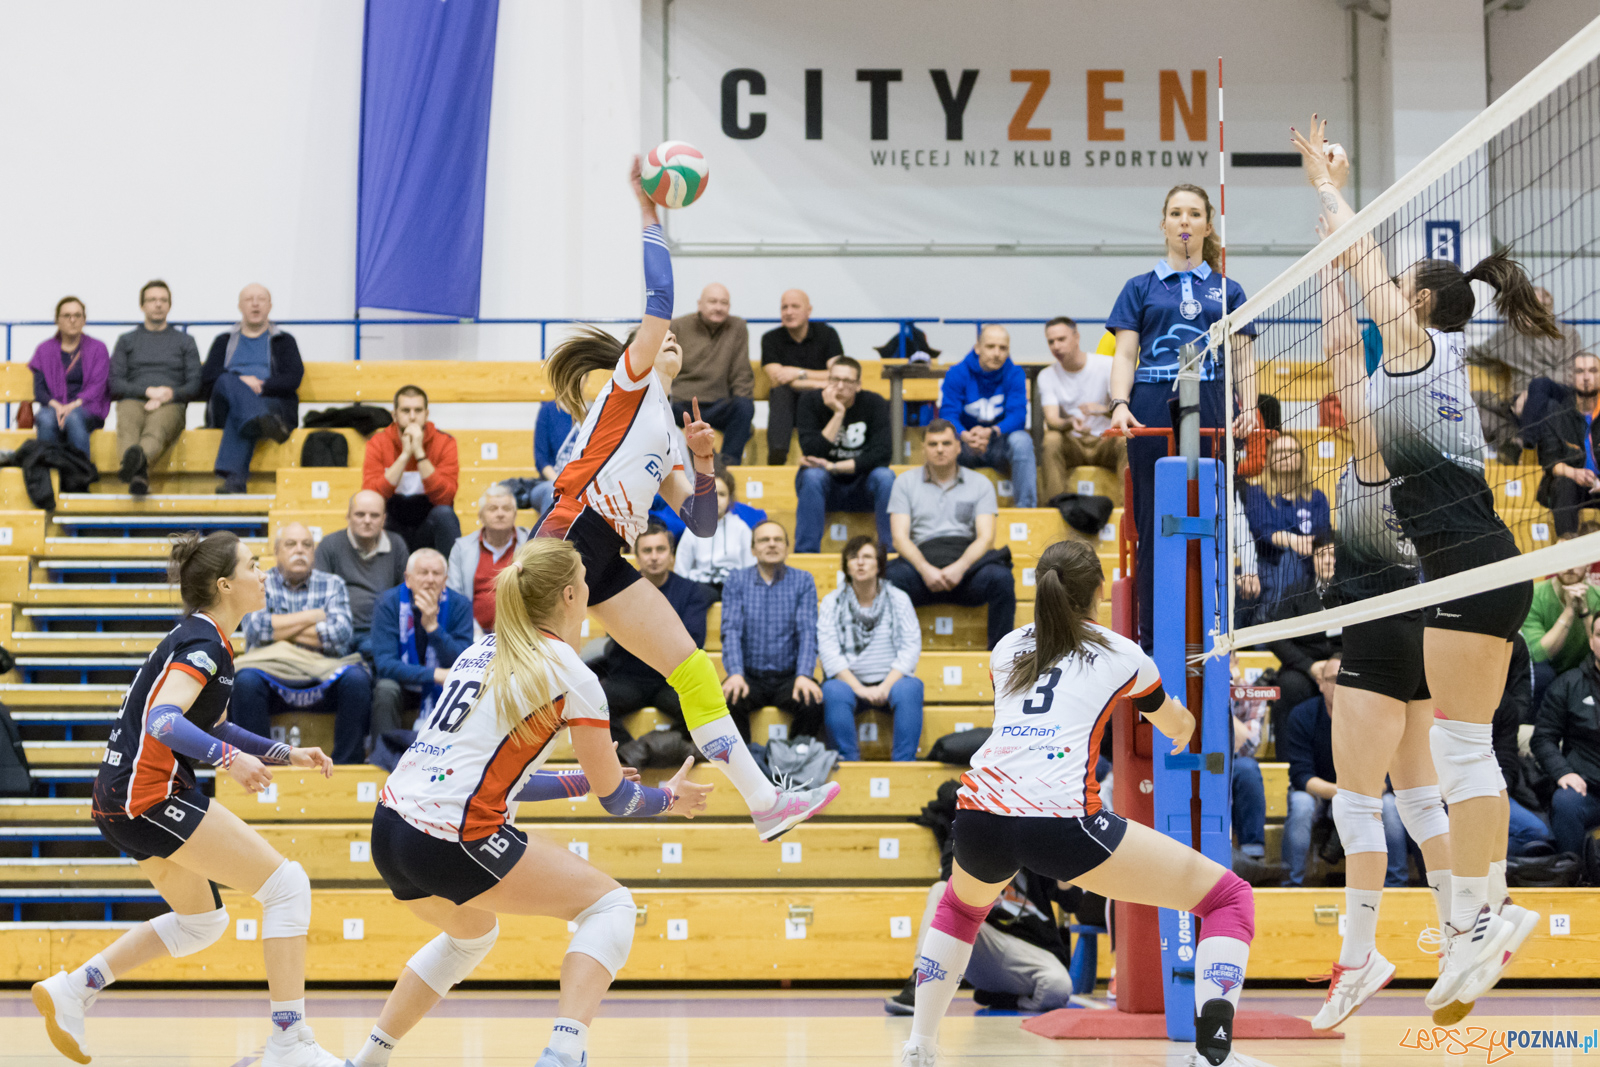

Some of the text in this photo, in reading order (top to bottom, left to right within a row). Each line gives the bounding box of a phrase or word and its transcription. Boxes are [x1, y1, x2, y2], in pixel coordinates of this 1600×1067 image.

[720, 68, 1208, 140] CITYZEN
[871, 149, 1209, 170] WIĘCEJ NIŻ KLUB SPORTOWY
[1022, 667, 1062, 714] 3
[1246, 688, 1277, 698] Senoh
[429, 680, 486, 733] 16
[164, 805, 185, 822] 8
[1094, 815, 1110, 831] 3
[479, 832, 510, 859] 16
[1555, 918, 1565, 927] 12
